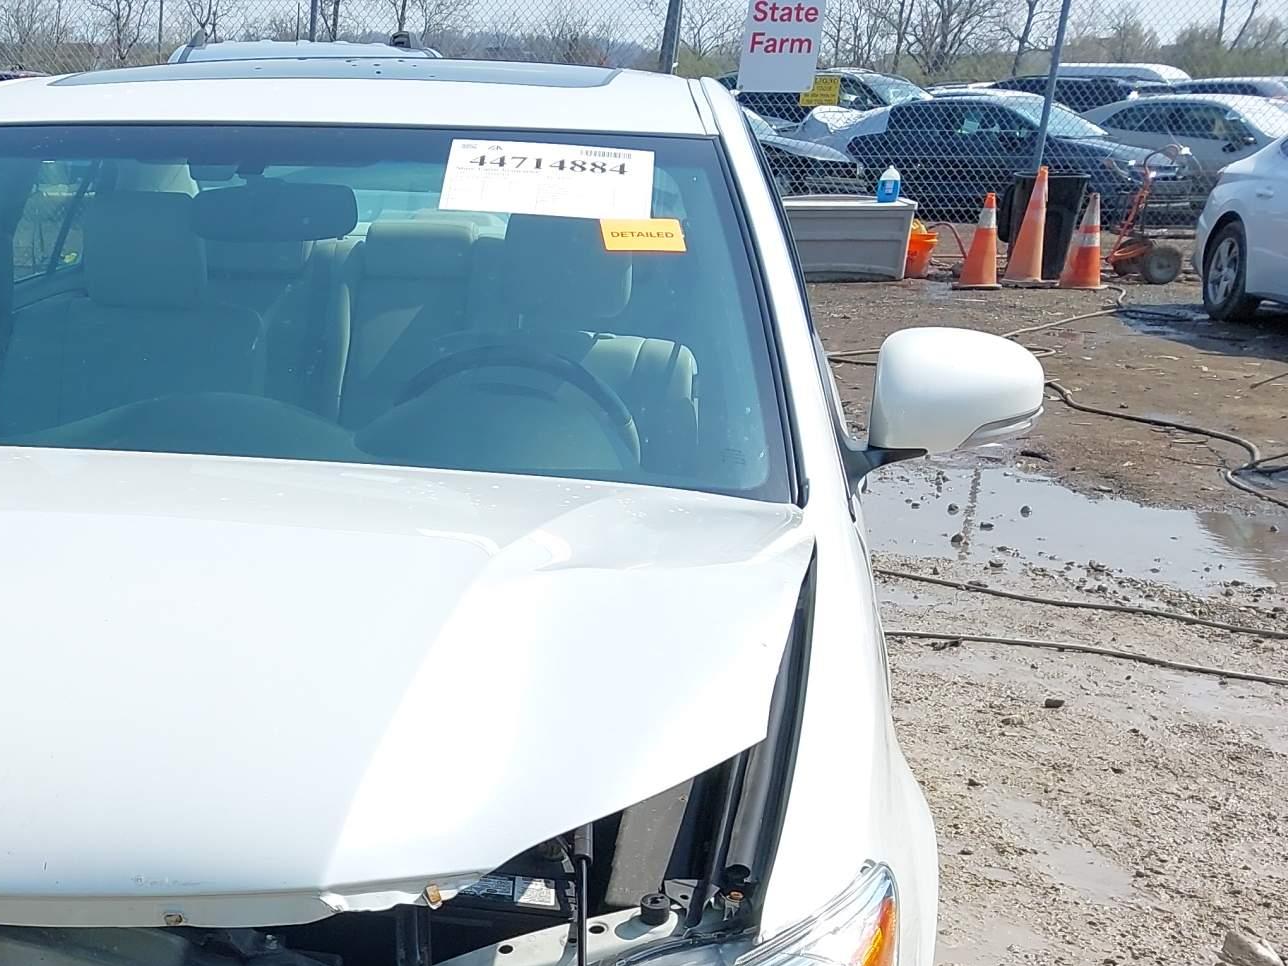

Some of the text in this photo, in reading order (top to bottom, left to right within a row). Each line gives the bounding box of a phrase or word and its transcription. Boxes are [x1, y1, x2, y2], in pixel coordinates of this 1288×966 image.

[753, 0, 819, 22] State
[750, 32, 813, 54] Farm
[469, 154, 628, 175] 44714884
[610, 231, 675, 239] DETAILED
